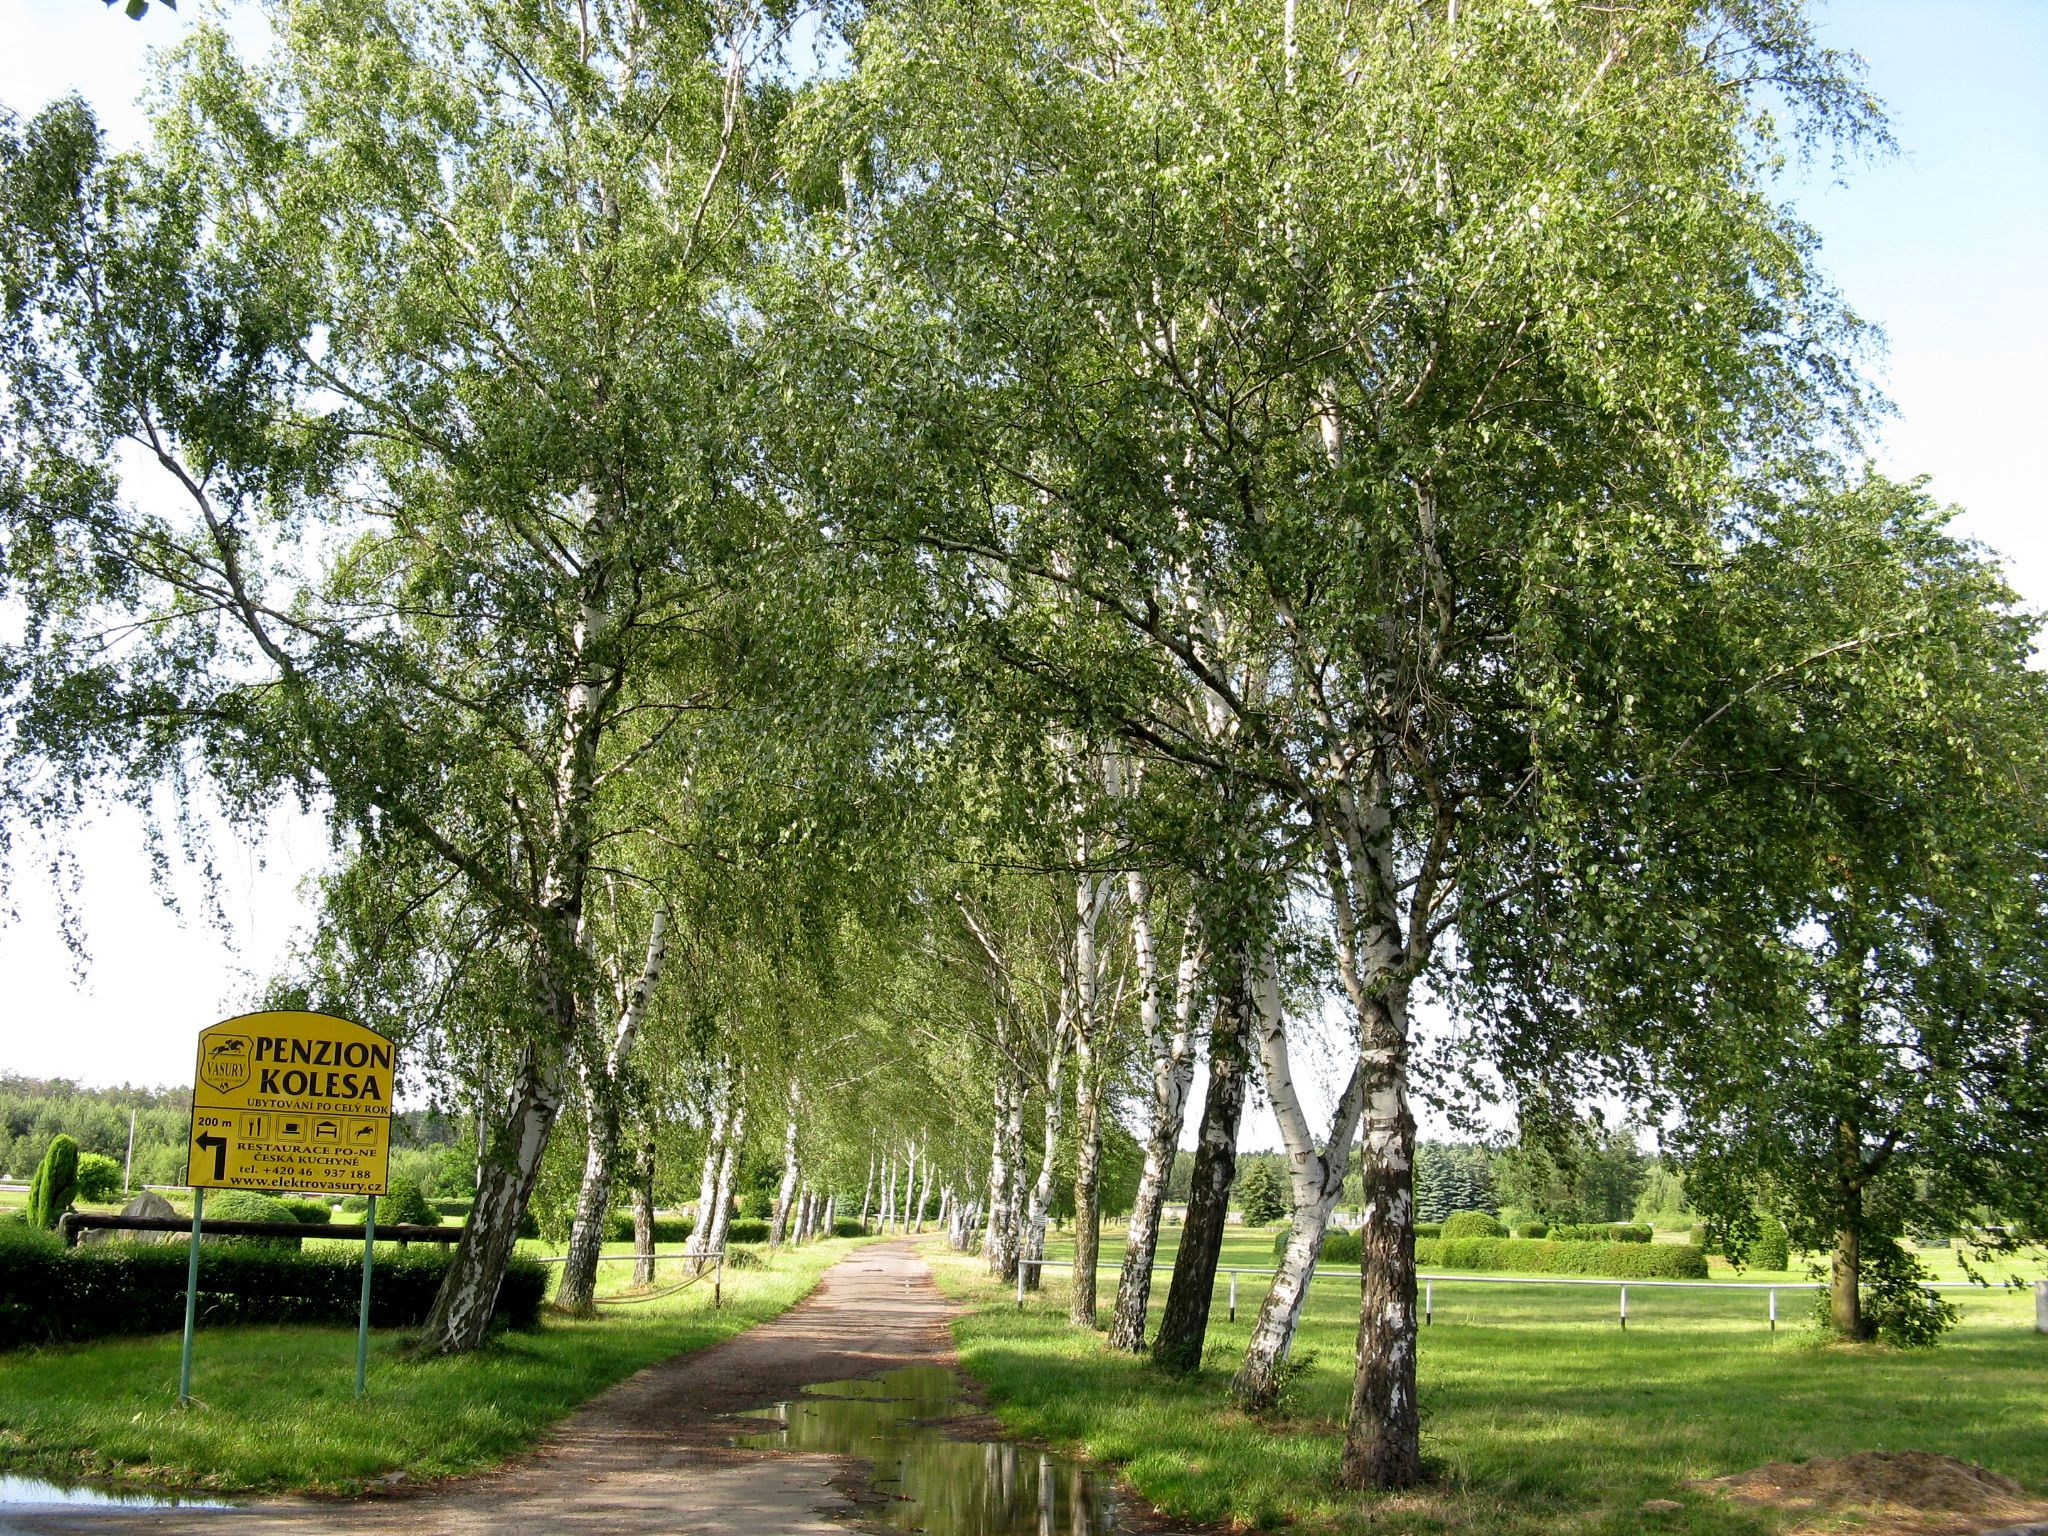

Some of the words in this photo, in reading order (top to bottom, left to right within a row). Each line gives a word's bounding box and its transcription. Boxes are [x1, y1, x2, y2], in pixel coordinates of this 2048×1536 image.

[255, 1036, 391, 1070] PENZION
[207, 1062, 245, 1077] VASURY
[260, 1068, 381, 1100] KOLESA
[247, 1098, 313, 1110] UBYTOVÁNÍ
[317, 1102, 331, 1111] PO
[334, 1102, 362, 1112] CELÝ
[365, 1105, 389, 1115] ROK
[198, 1117, 218, 1127] 200
[237, 1142, 330, 1155] RESTAURACE
[334, 1147, 377, 1157] PO-NE
[254, 1152, 294, 1163] ČESKÁ
[239, 1165, 258, 1174] tel.
[264, 1166, 294, 1175] +420
[298, 1168, 313, 1176] 46
[324, 1169, 346, 1178] 937
[350, 1170, 371, 1179] 188
[230, 1176, 382, 1193] www.elektrovasury.cz
